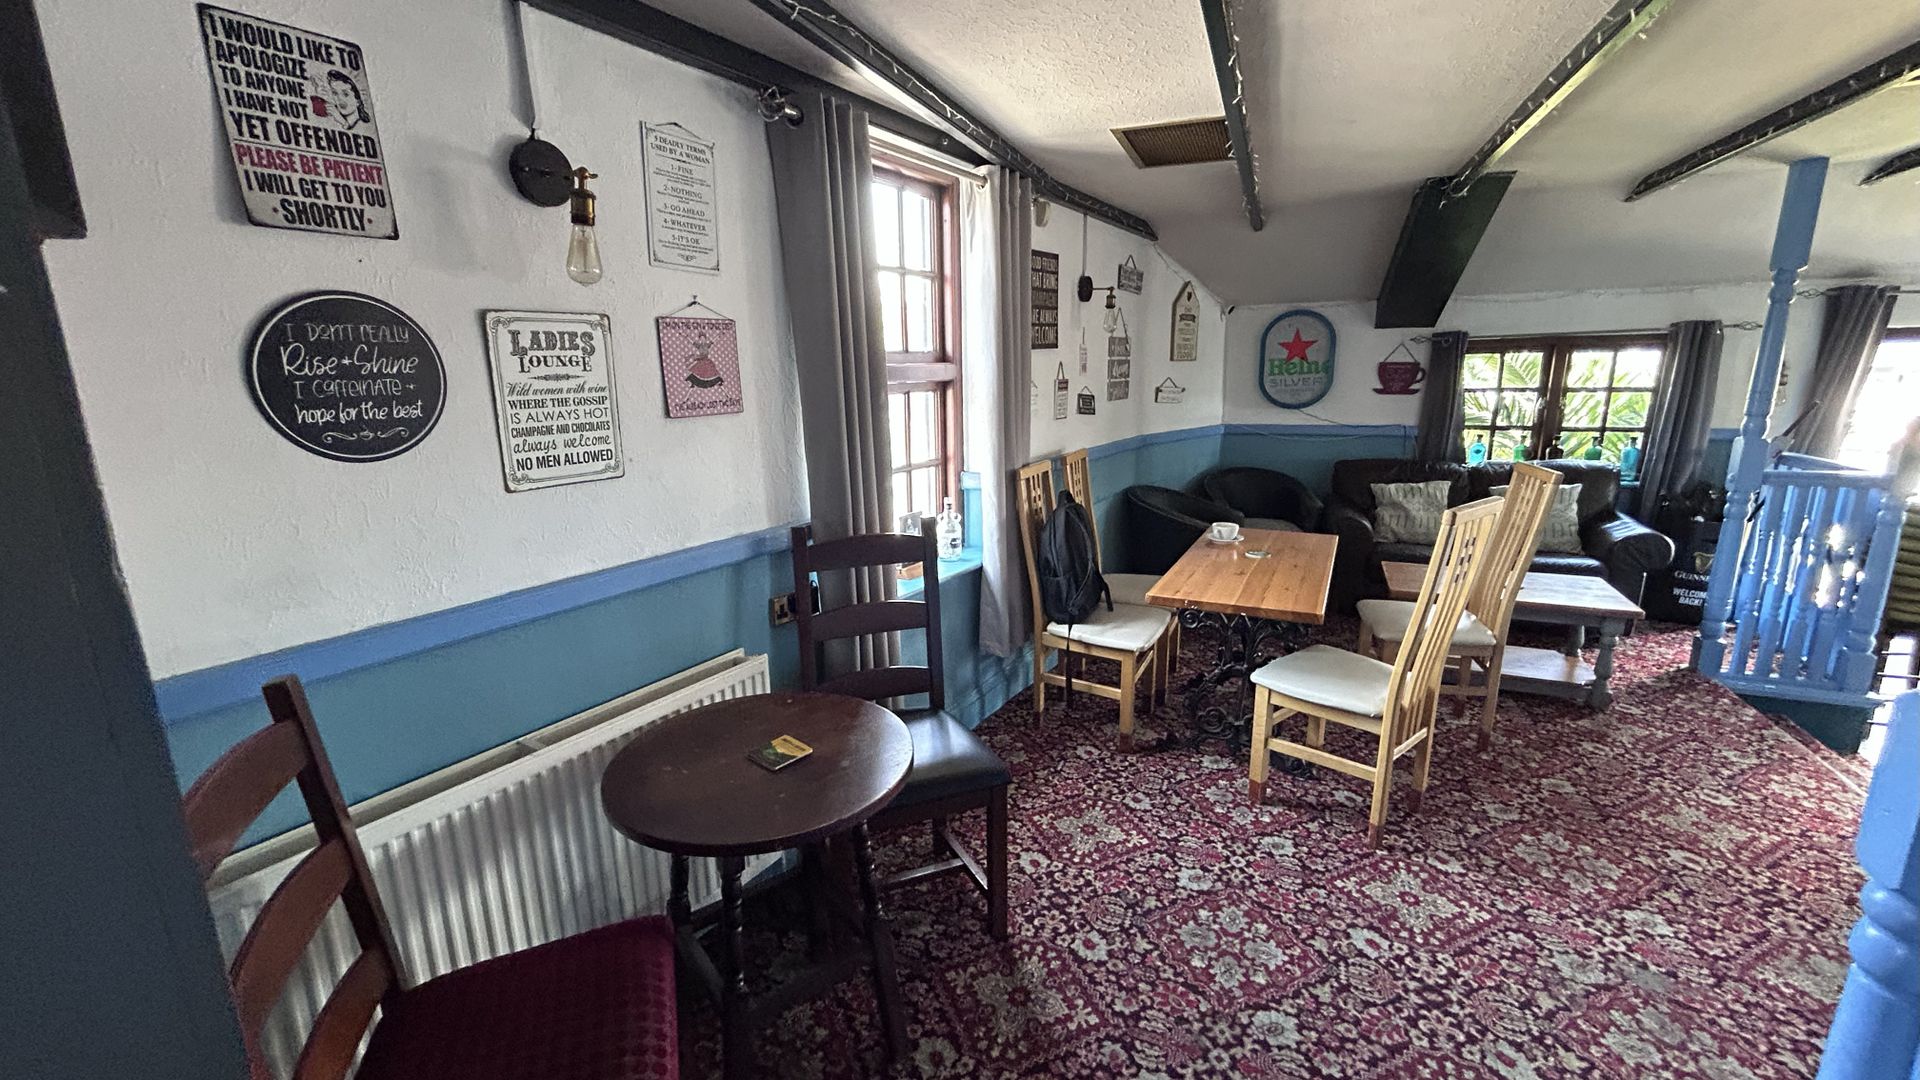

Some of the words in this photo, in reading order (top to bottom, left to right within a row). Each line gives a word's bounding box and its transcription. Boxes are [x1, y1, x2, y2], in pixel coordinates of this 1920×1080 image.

[208, 12, 218, 37] I
[219, 16, 294, 54] WOULD
[295, 36, 335, 65] LIKE
[336, 46, 361, 71] TO
[214, 40, 310, 81] APOLOGIZE
[218, 64, 242, 86] TO
[245, 70, 307, 99] ANYONE
[224, 88, 232, 106] I
[233, 89, 277, 115] HAVE
[278, 99, 309, 120] NOT
[229, 110, 270, 142] YET
[275, 119, 378, 159] OFFENDED
[650, 142, 668, 152] USED
[669, 147, 677, 156] BY
[685, 152, 710, 164] WOMAN
[659, 136, 684, 149] DEADLY
[686, 144, 706, 156] TERMS
[234, 143, 299, 173] PLEASE
[300, 153, 322, 177] BE
[322, 157, 383, 186] PATIENT
[678, 165, 693, 175] FINE
[244, 169, 253, 191] I
[253, 171, 298, 197] WILL
[299, 178, 328, 200] GET
[331, 182, 353, 204] TO
[354, 185, 386, 208] YOU
[670, 185, 703, 199] NOTHING
[280, 198, 365, 231] SHORTLY
[670, 204, 681, 212] GO
[681, 207, 705, 217] AHEAD
[670, 219, 706, 232] WHATEVER
[690, 237, 701, 245] OK
[285, 323, 296, 342] I
[508, 329, 596, 357] LADIES
[280, 342, 338, 376] Rise
[352, 344, 419, 375] Shine
[518, 355, 592, 374] LOUNGE
[293, 381, 305, 399] I
[506, 383, 531, 397] Wild
[532, 386, 565, 396] women
[566, 382, 587, 395] with
[588, 385, 608, 394] wine
[1270, 377, 1322, 387] SILVER
[508, 398, 549, 410] WHERE
[552, 397, 571, 408] THE
[572, 395, 608, 406] GOSSIP
[294, 403, 335, 426] hope
[339, 402, 359, 423] for
[359, 401, 388, 420] the
[393, 400, 423, 418] best
[510, 412, 521, 424] IS
[526, 409, 580, 423] ALWAYS
[584, 407, 609, 419] HOT
[511, 424, 555, 438] CHAMPAGNE
[556, 423, 570, 434] AND
[571, 421, 610, 433] CHOCOLATES
[514, 438, 557, 454] always
[563, 434, 611, 449] welcome
[516, 457, 533, 471] NO
[536, 454, 561, 469] MEN
[564, 449, 613, 465] ALLOWED
